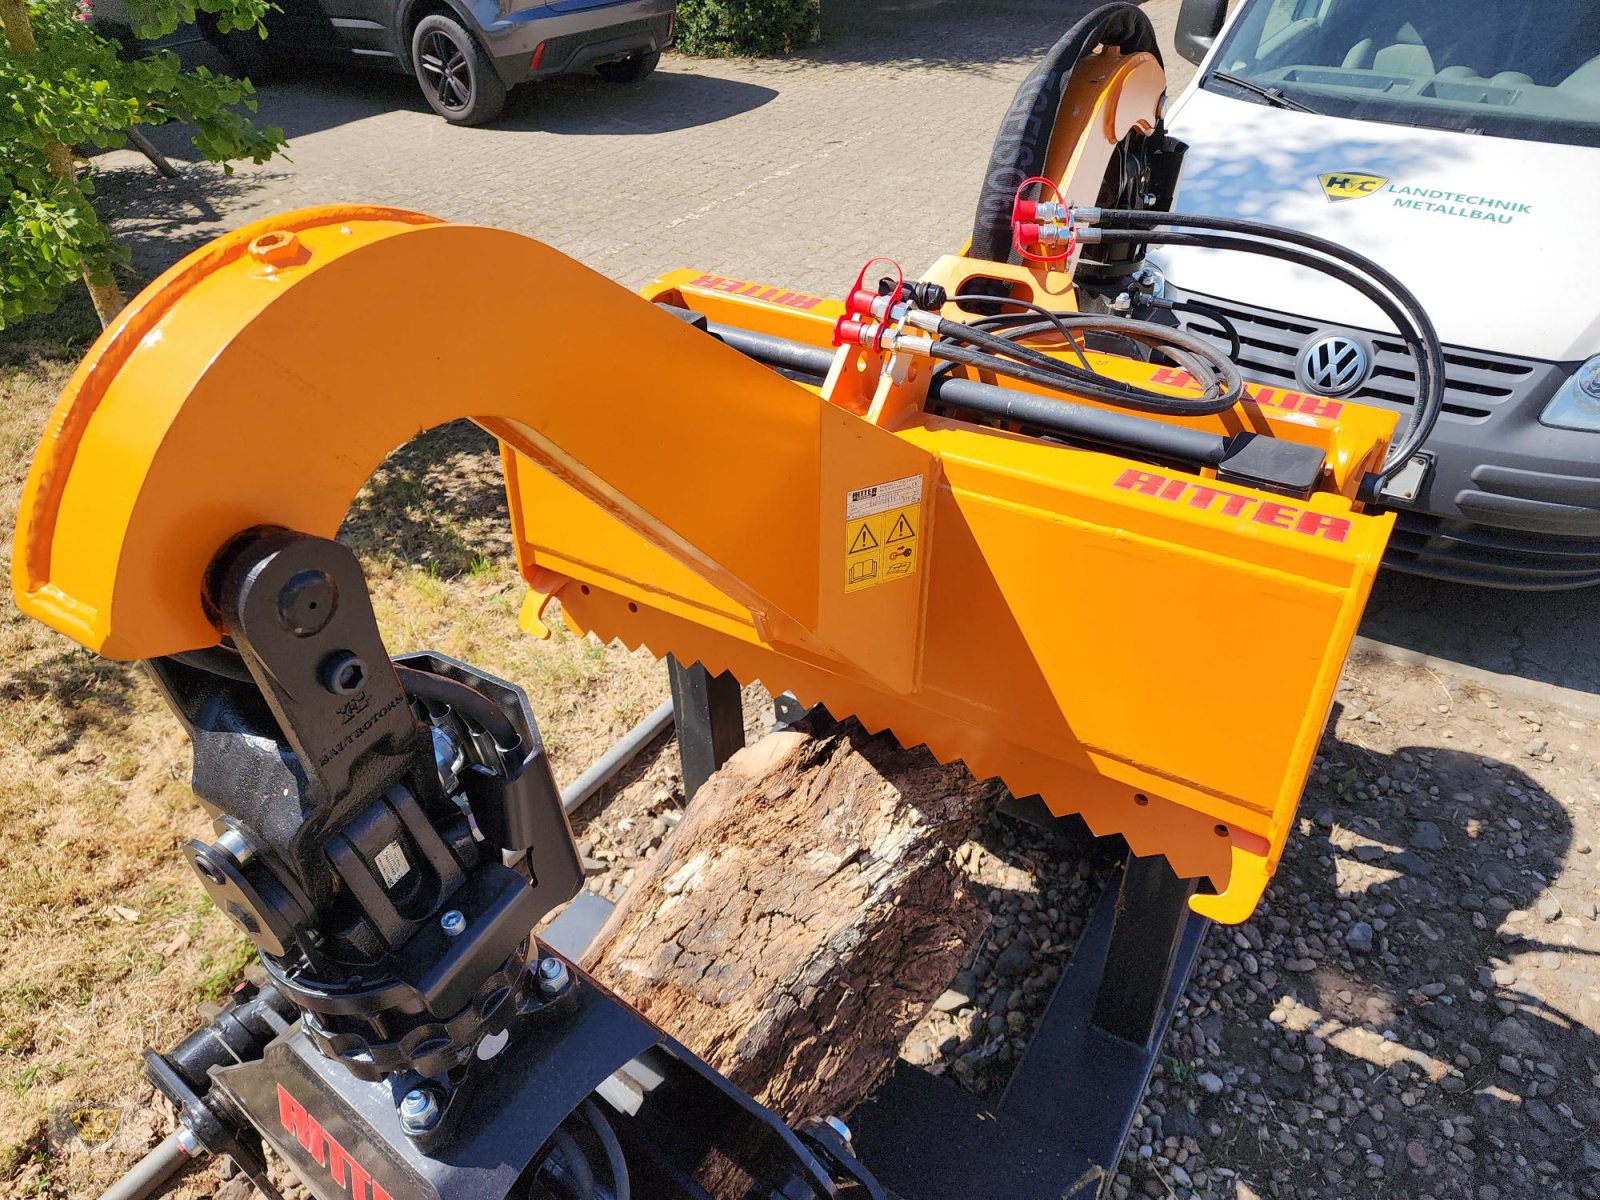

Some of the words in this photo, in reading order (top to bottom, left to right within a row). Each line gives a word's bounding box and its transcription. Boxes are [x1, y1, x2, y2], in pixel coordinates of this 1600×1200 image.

[1387, 184, 1533, 214] LANDTECHNIK
[1393, 198, 1513, 225] METALLBAU
[689, 274, 822, 310] RITTER
[1113, 468, 1351, 543] RITTER
[320, 696, 404, 767] BALTROTORS
[277, 1083, 394, 1200] RITT
